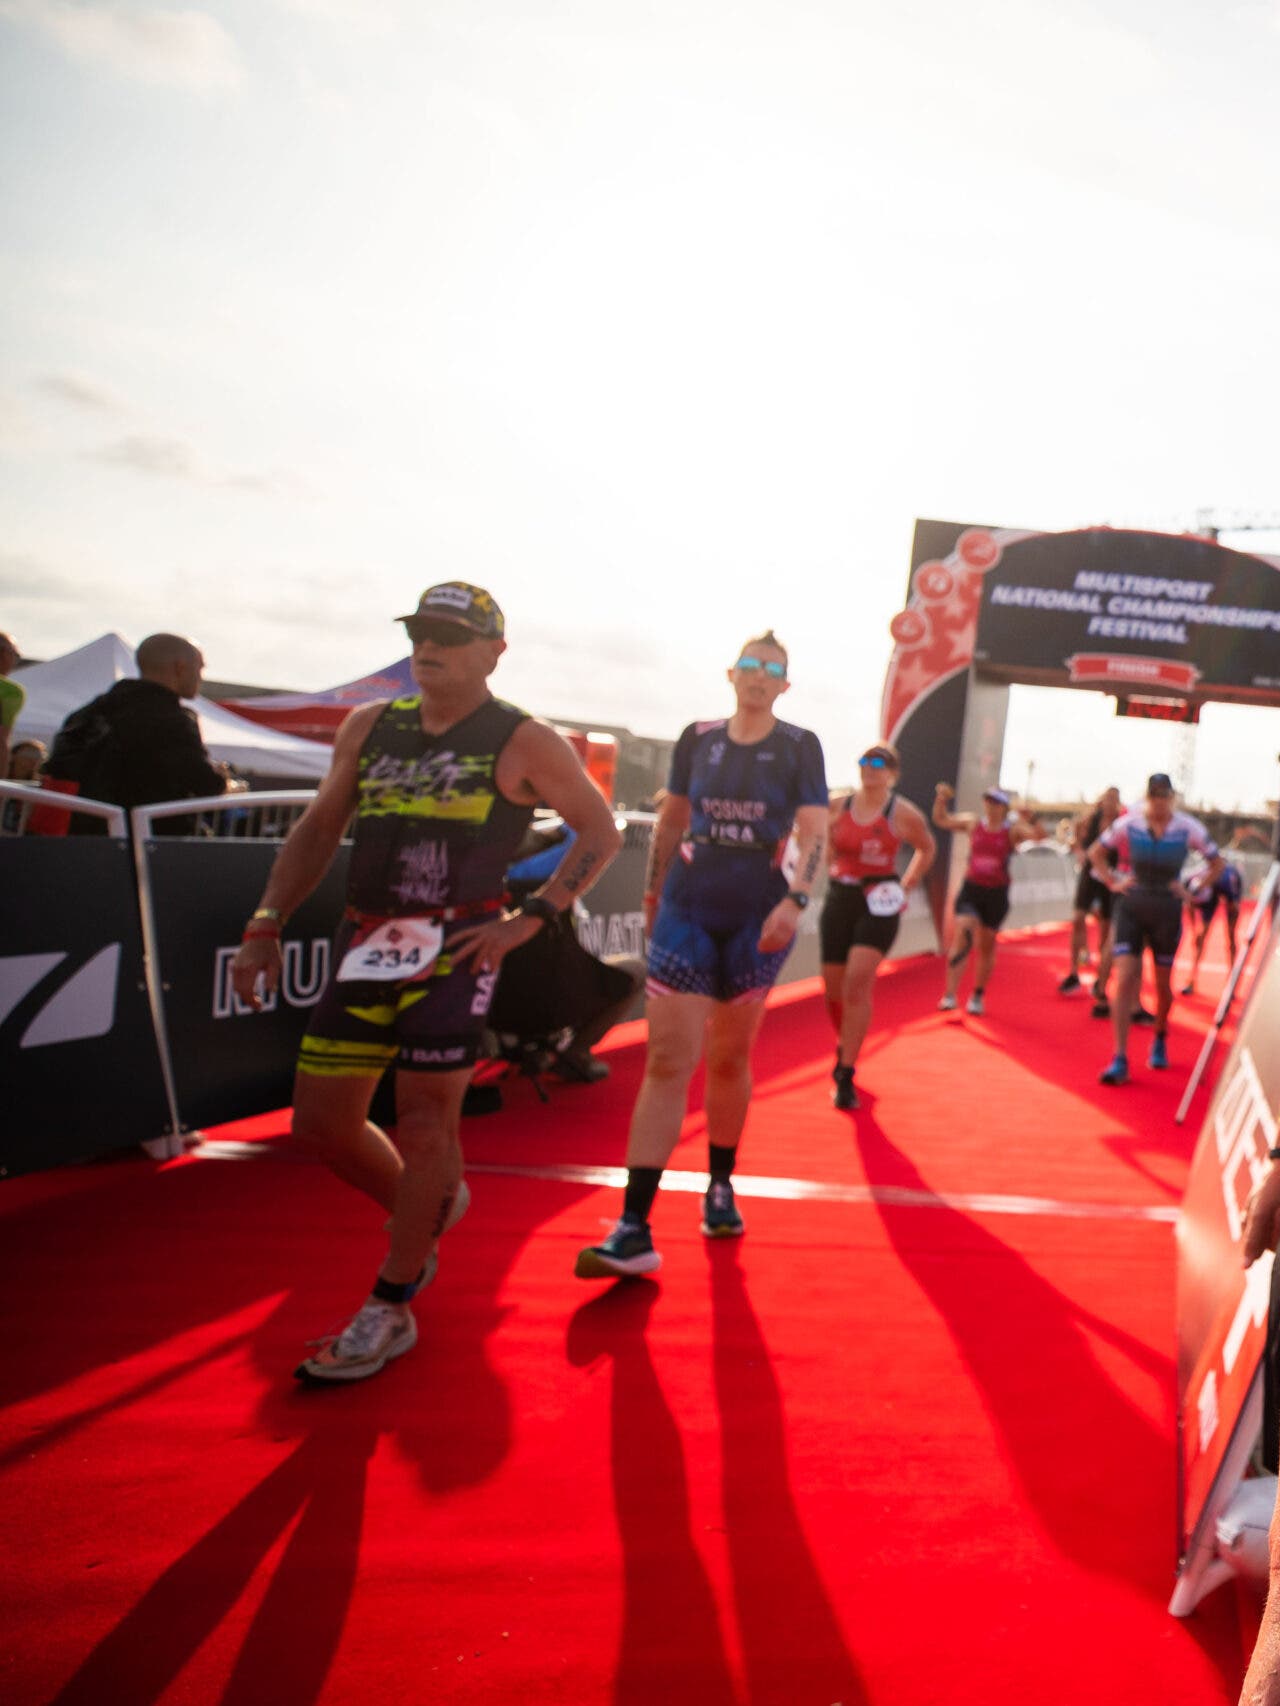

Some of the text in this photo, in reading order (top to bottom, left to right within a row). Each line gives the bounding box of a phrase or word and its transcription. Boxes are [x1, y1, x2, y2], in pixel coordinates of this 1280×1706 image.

[991, 585, 1102, 613] NATIONAL
[1073, 570, 1213, 601] MULTISPORT
[1087, 616, 1188, 644] FESTIVAL
[362, 947, 421, 968] 234
